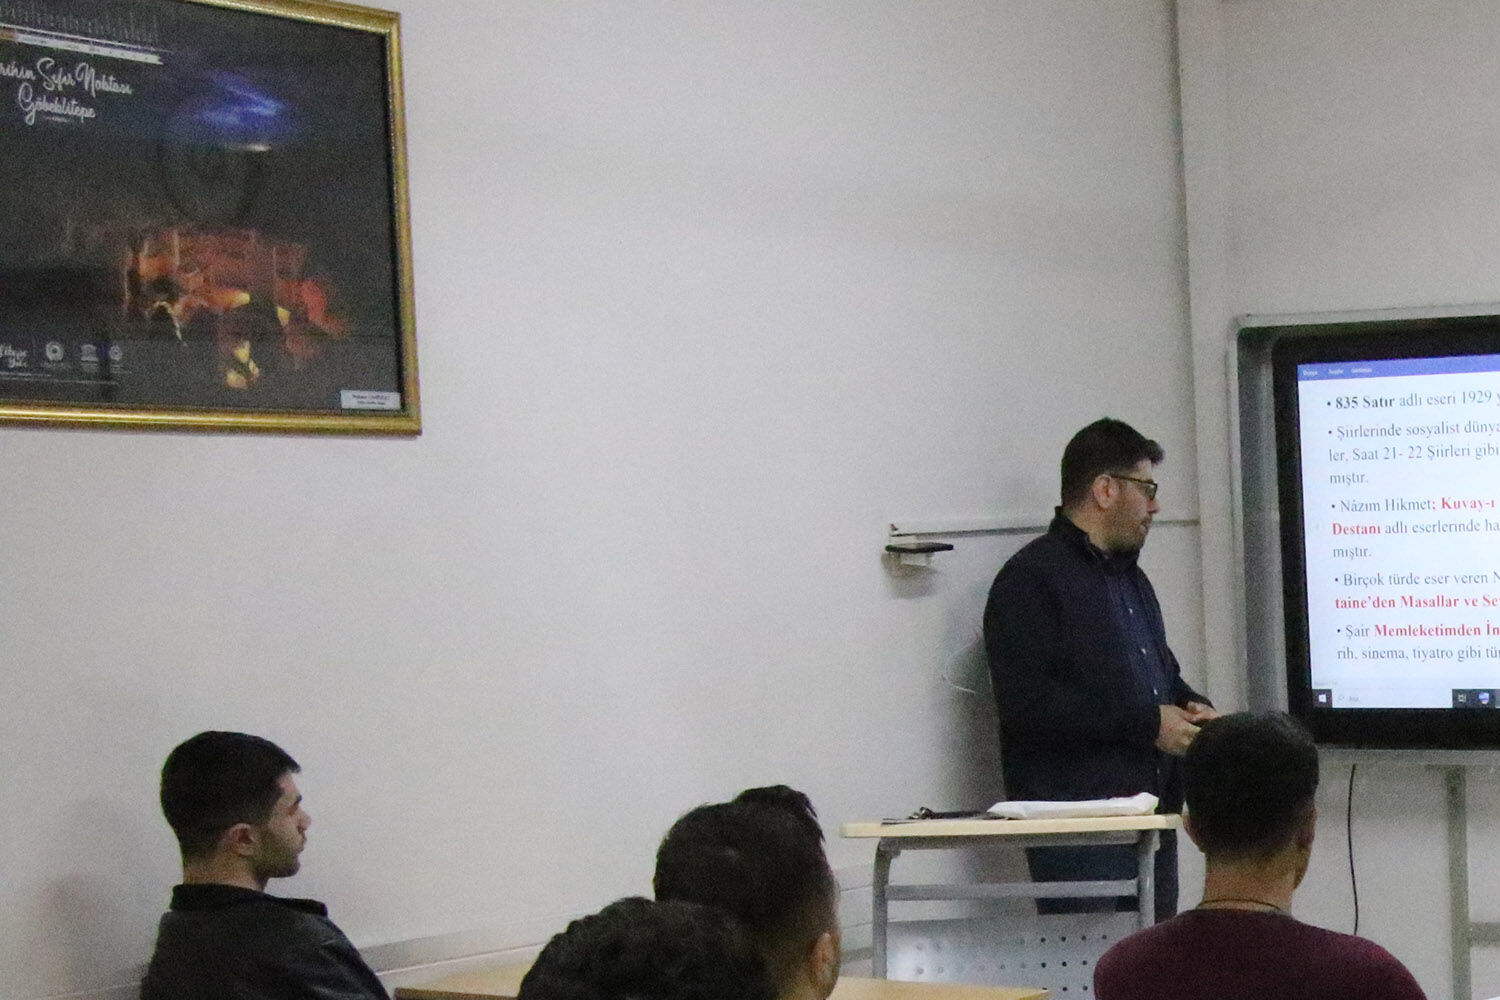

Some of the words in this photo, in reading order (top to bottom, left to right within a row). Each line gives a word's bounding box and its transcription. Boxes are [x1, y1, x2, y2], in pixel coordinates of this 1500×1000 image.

[1336, 396, 1358, 409] 835
[1363, 396, 1395, 408] Satır
[1400, 393, 1422, 406] adlı
[1427, 393, 1456, 405] eseri
[1462, 390, 1492, 404] 1929
[1337, 423, 1402, 440] Şiirlerinde
[1406, 421, 1460, 439] sosyalist
[1353, 448, 1378, 460] Saat
[1408, 445, 1422, 459] 22
[1427, 444, 1470, 461] Şiirleri
[1475, 443, 1499, 460] gibi
[1340, 500, 1380, 512] Nâzım
[1441, 497, 1495, 512] Kuvay-ı
[1332, 523, 1381, 535] Destanı
[1385, 521, 1408, 534] adlı
[1412, 519, 1480, 533] eserlerinde
[1344, 572, 1384, 588] Birçok
[1389, 572, 1420, 585] türde
[1424, 575, 1450, 584] eser
[1453, 575, 1488, 584] veren
[1401, 594, 1459, 608] Masallar
[1464, 598, 1478, 607] ve
[1345, 625, 1370, 639] Şair
[1374, 623, 1481, 637] Memleketimden
[1413, 647, 1453, 662] tiyatro
[1458, 646, 1481, 662] gibi
